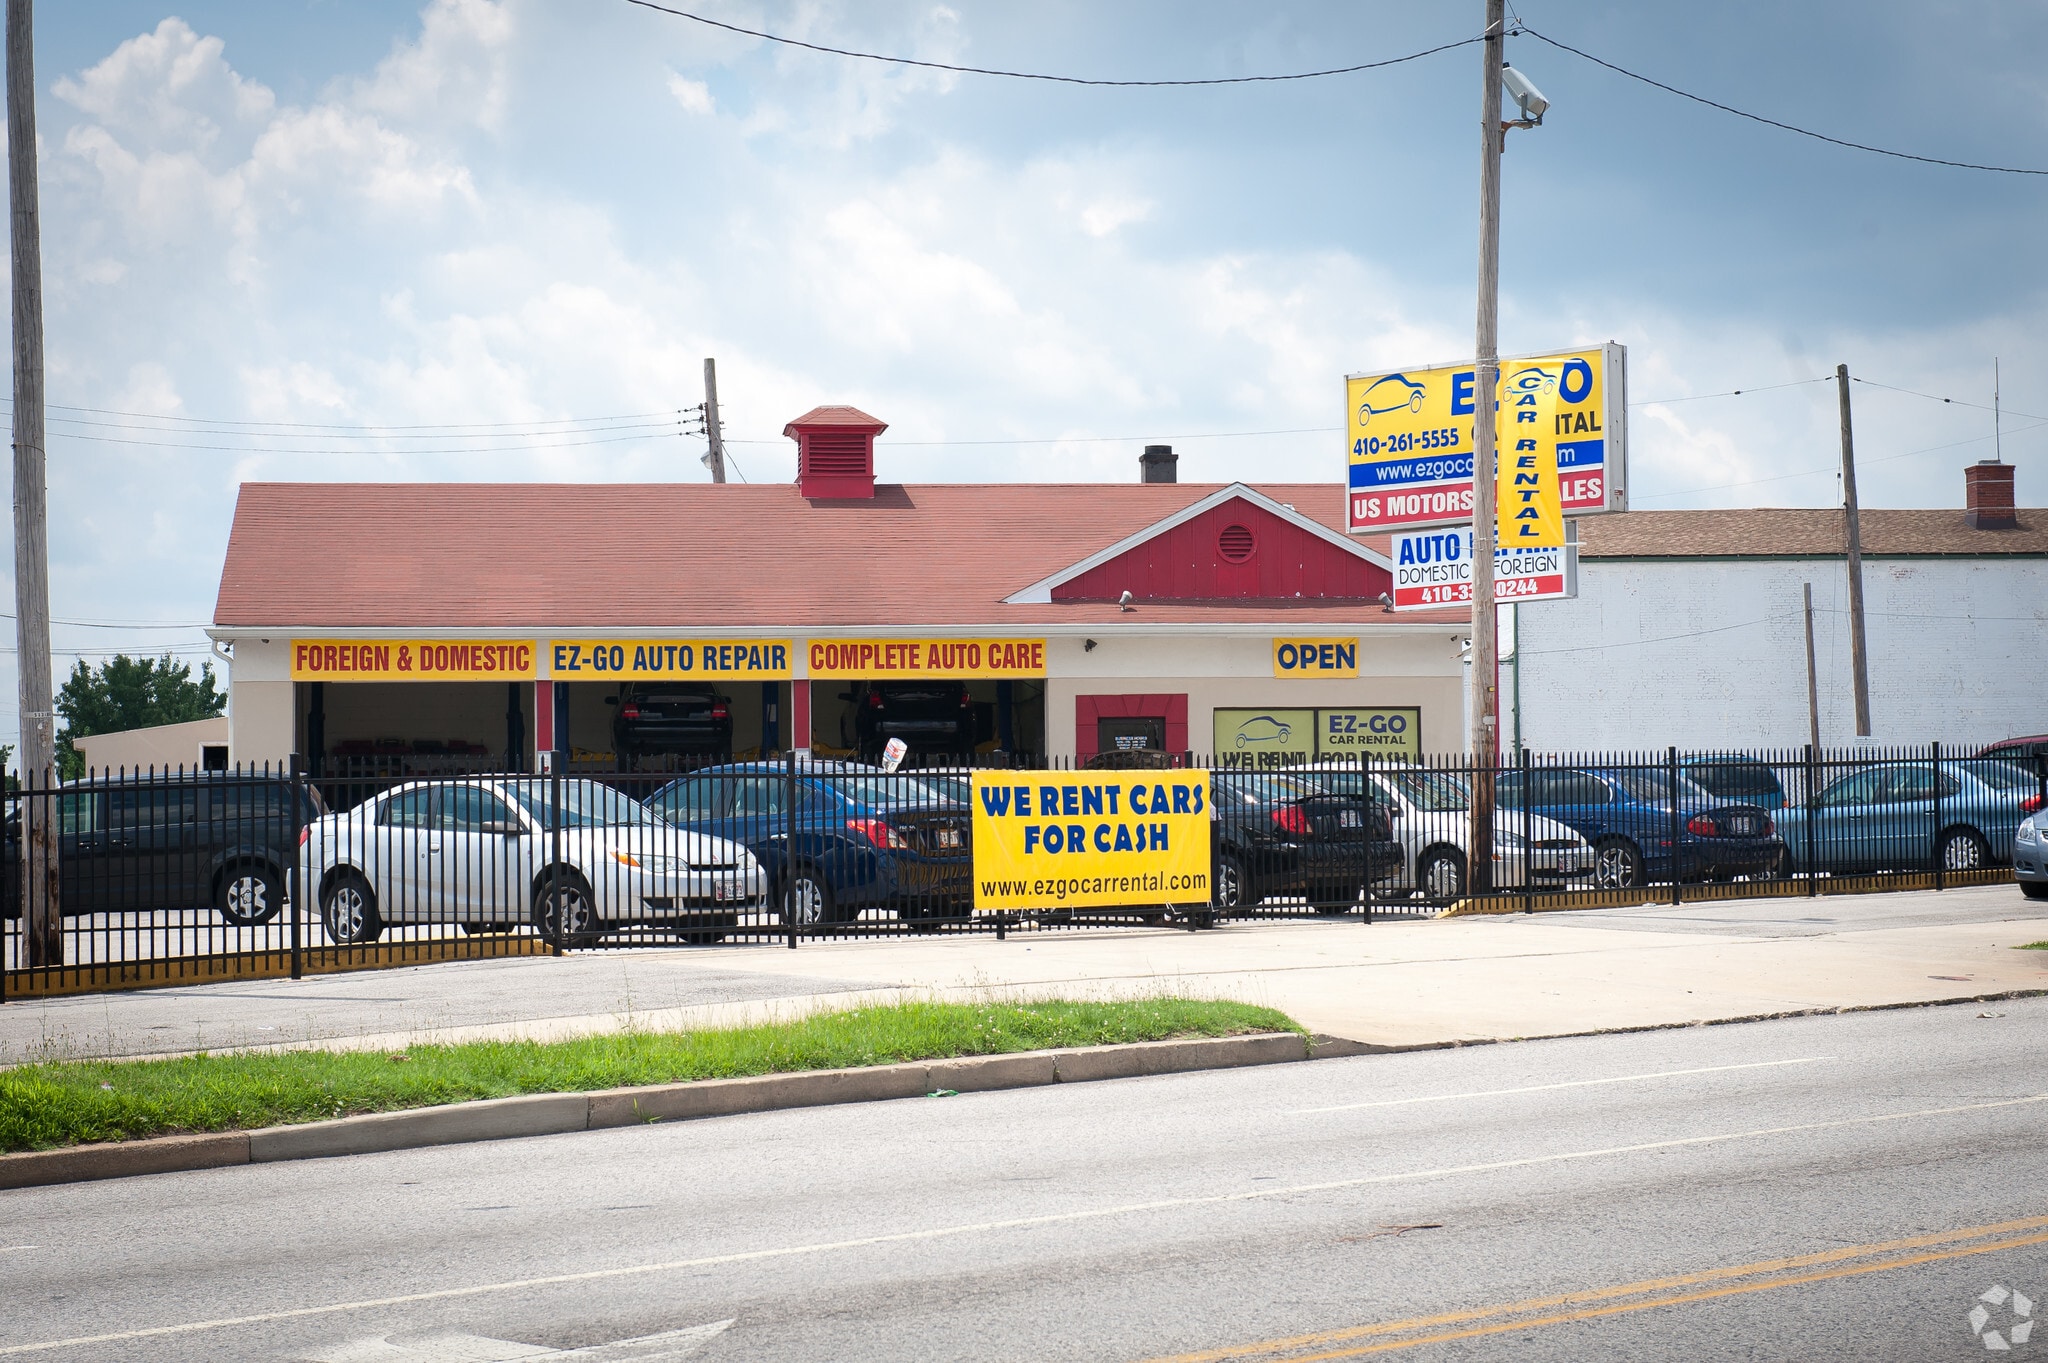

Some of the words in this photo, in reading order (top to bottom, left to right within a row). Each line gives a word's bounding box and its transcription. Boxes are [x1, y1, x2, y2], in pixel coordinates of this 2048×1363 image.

[1515, 377, 1541, 423] CAR
[1556, 411, 1601, 435] TAL
[1353, 428, 1459, 456] 410-261-5555
[1514, 439, 1540, 536] RENTAL
[1354, 498, 1381, 519] US
[1387, 490, 1473, 517] MOTORS
[1399, 533, 1461, 565] AUTO
[1400, 563, 1470, 584] DOMESTIC
[296, 645, 389, 671] FOREIGN
[397, 645, 413, 671] &
[420, 645, 530, 671] DOMESTIC
[554, 645, 624, 671] EZ-GO
[633, 645, 694, 671] AUTO
[703, 645, 786, 670] REPAIR
[810, 643, 921, 670] COMPLETE
[927, 643, 981, 670] AUTO
[988, 643, 1043, 669] CARE
[1277, 643, 1356, 670] OPEN
[1329, 715, 1407, 733] EZ-GO
[1329, 735, 1354, 745] CAR
[1358, 735, 1406, 745] RENTAL
[1223, 752, 1252, 766] WE
[1258, 752, 1306, 766] RENT
[980, 786, 1032, 816] WE
[1040, 785, 1121, 815] RENT
[1129, 784, 1204, 815] CARS
[1024, 824, 1086, 854] FOR
[1094, 823, 1169, 853] CASH
[980, 871, 1206, 899] www.ezgocarrental.com
